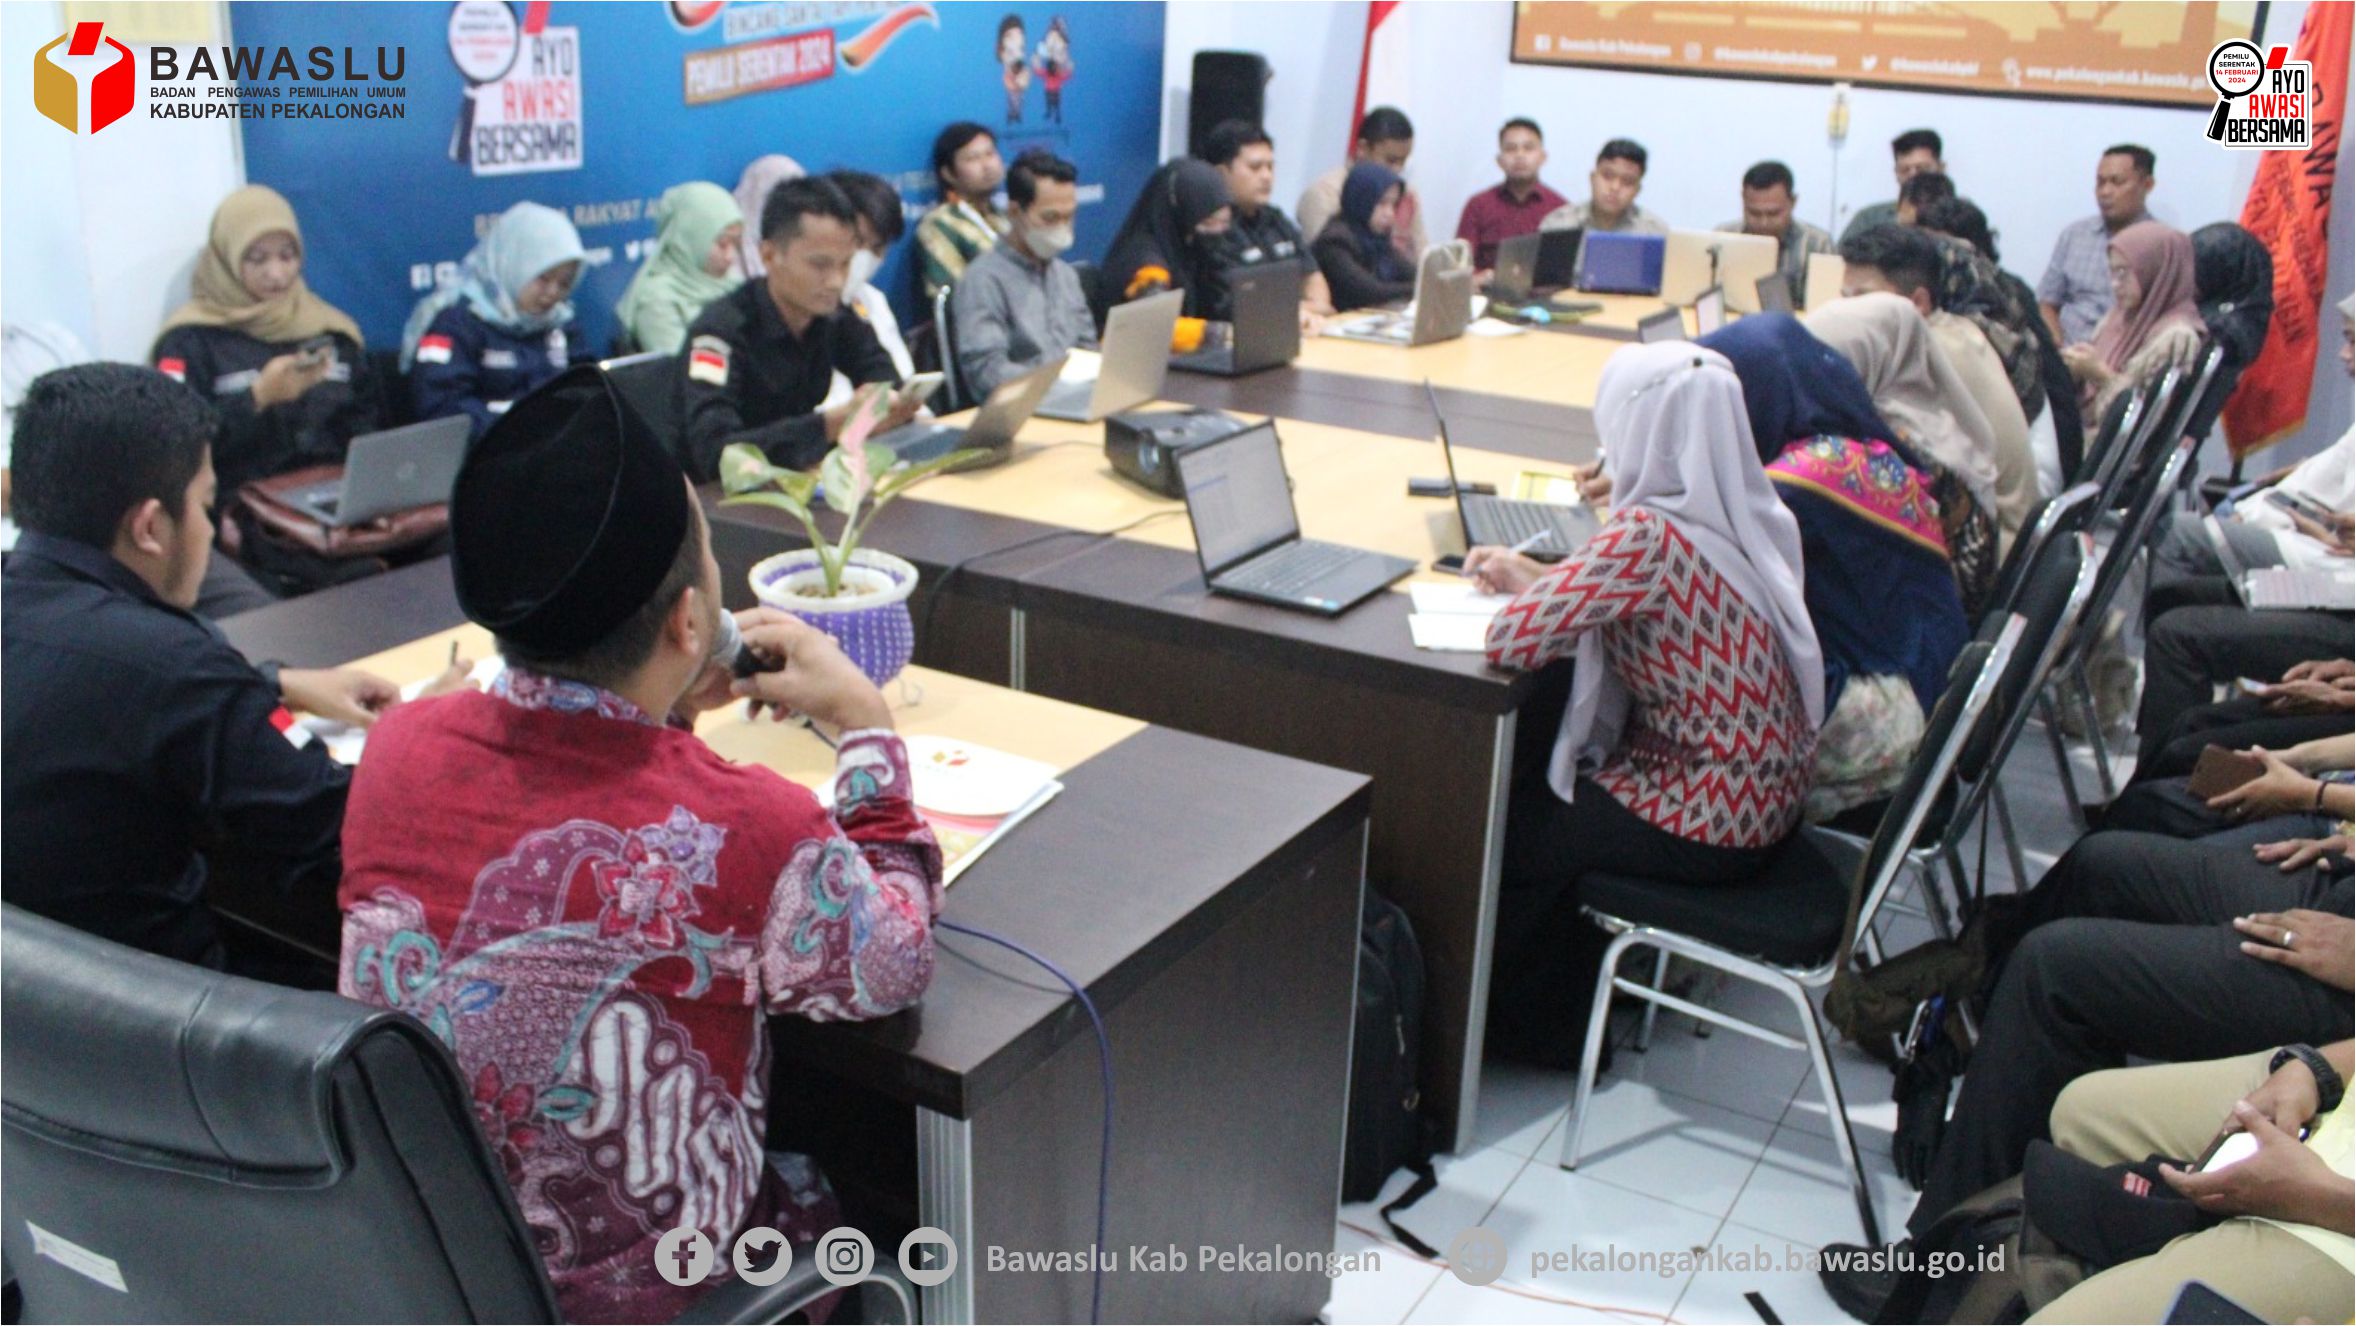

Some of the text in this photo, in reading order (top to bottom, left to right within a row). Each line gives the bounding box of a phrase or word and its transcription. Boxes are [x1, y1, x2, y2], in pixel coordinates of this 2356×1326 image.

[533, 36, 573, 76] AYO
[687, 53, 735, 96] PEMILU
[799, 35, 832, 73] 2024
[503, 80, 576, 121] AWASI
[476, 122, 577, 167] BERSAMA
[574, 198, 642, 227] RAKYAT
